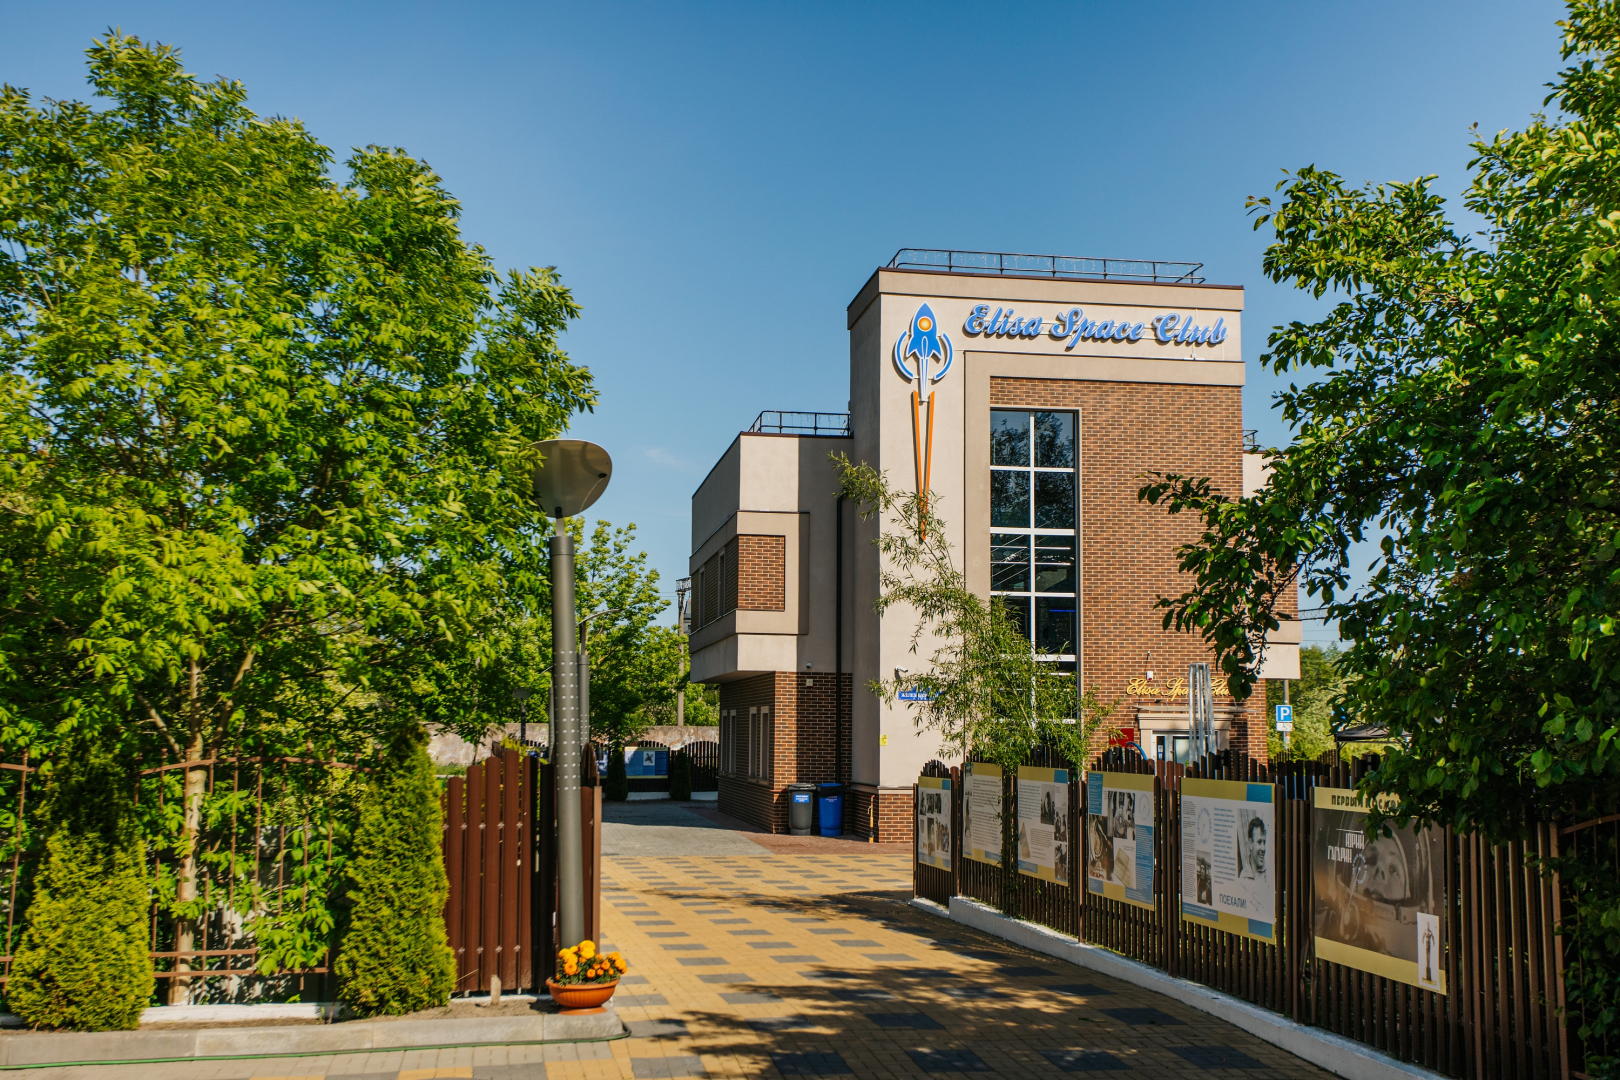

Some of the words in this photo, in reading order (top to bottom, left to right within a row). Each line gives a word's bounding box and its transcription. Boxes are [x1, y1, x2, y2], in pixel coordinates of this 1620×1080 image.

[963, 303, 1044, 337] Elisa
[1051, 307, 1145, 349] Space
[1152, 312, 1228, 345] Club
[1126, 677, 1161, 695] Elisa
[1161, 677, 1198, 701] Spa
[1280, 706, 1290, 720] P
[1345, 832, 1365, 850] ЮРИЙ
[1327, 845, 1352, 864] ГАГАРИН
[1219, 893, 1247, 909] ПОЕХАЛИ!
